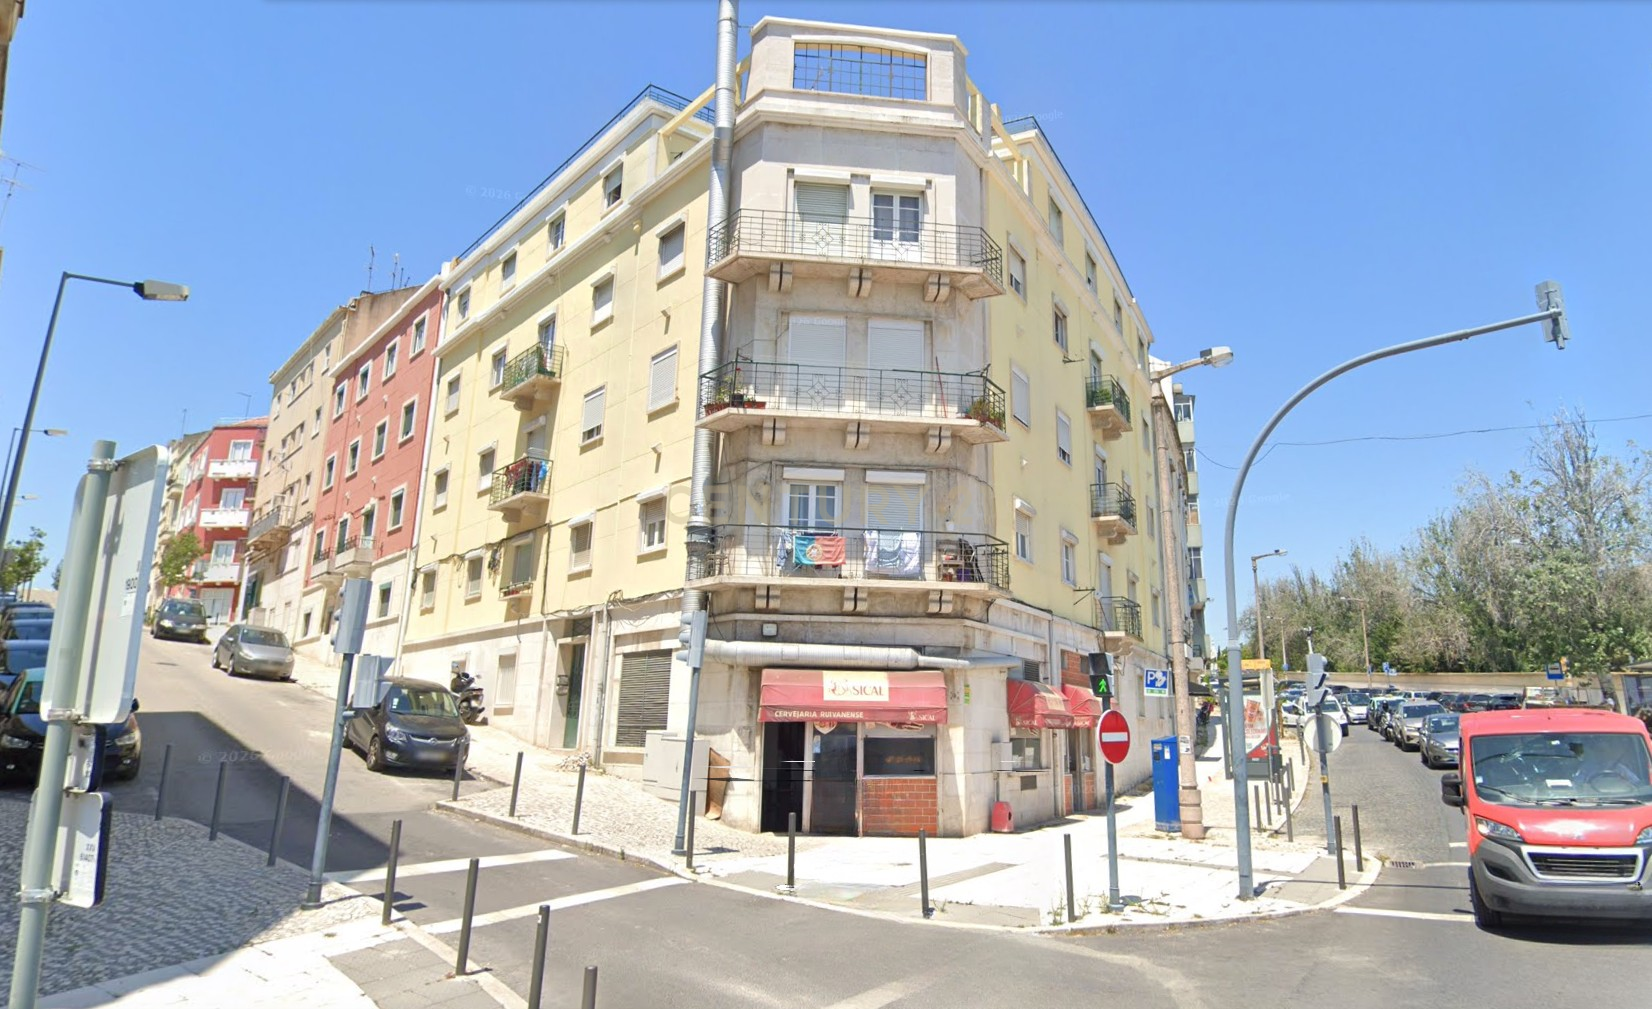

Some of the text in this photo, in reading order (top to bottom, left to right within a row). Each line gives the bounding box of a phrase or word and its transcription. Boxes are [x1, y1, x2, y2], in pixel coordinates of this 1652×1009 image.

[853, 685, 884, 696] SICAL
[775, 710, 864, 719] CERVEJARIA RUIVANENSE
